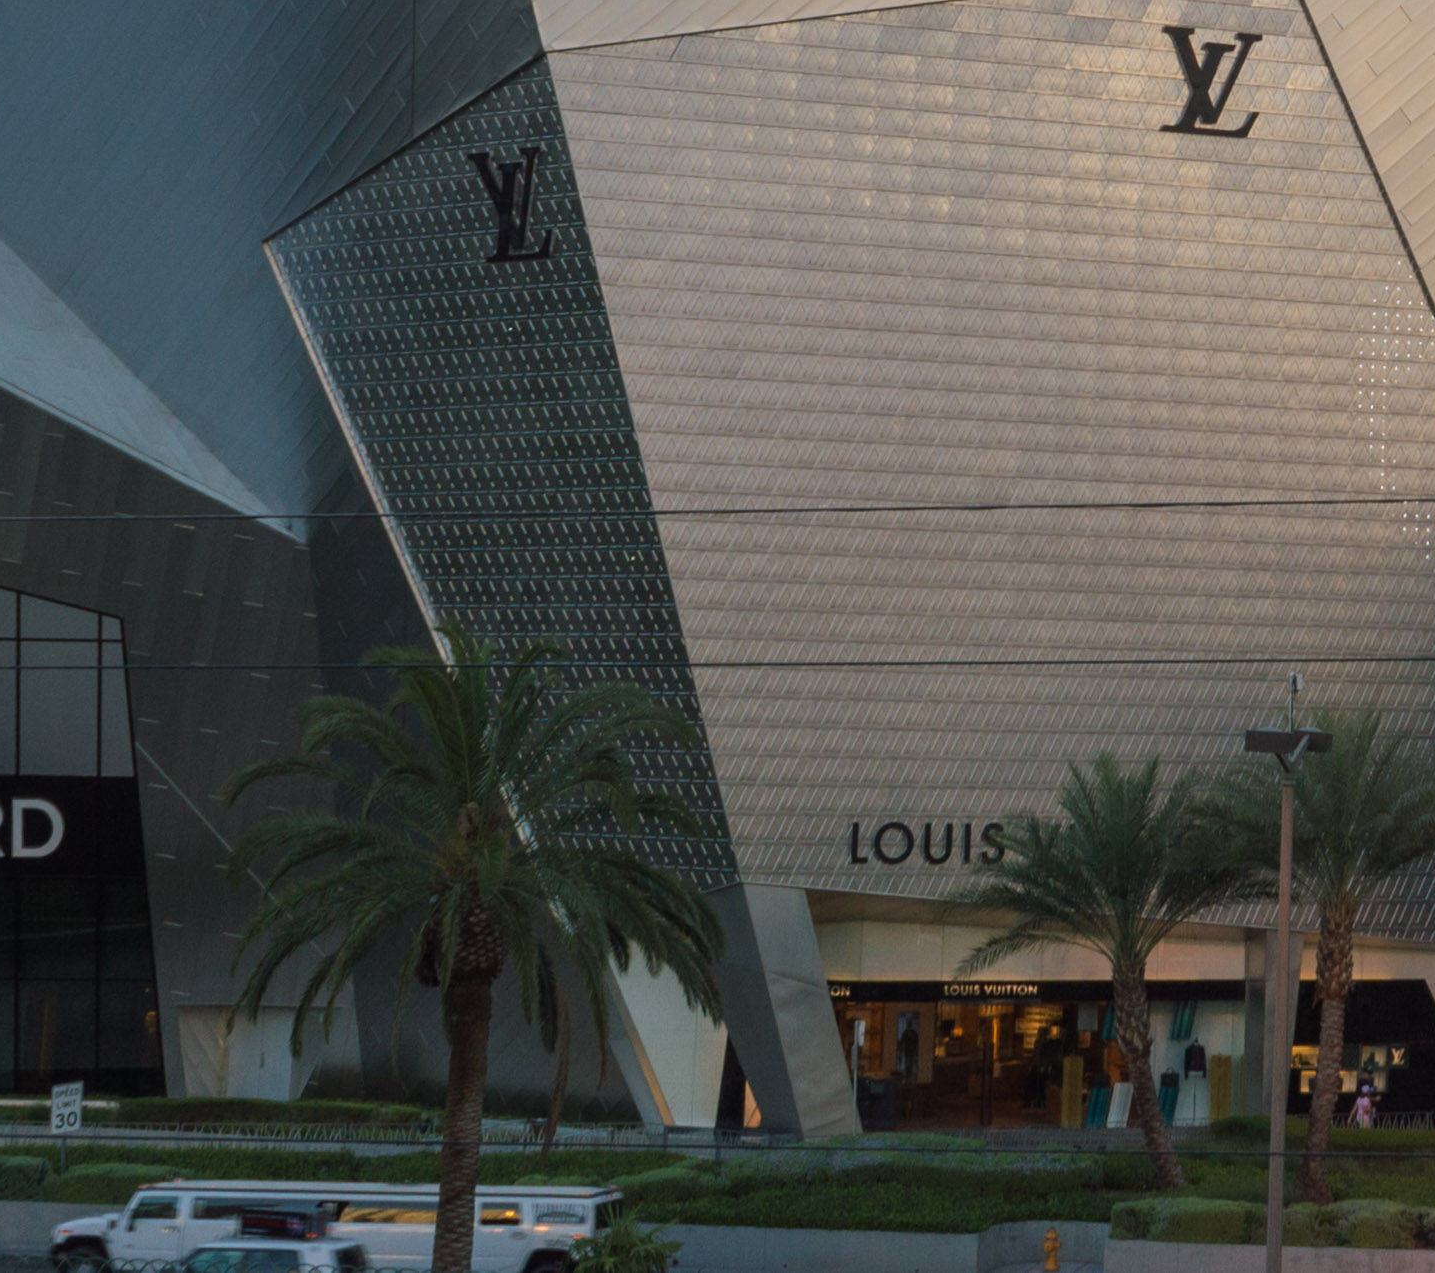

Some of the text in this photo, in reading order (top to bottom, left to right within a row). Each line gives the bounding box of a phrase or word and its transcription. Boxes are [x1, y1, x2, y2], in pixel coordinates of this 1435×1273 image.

[848, 820, 1006, 866] LOUIS
[944, 983, 1039, 997] LOUIS VUITTON
[55, 1111, 78, 1129] 30
